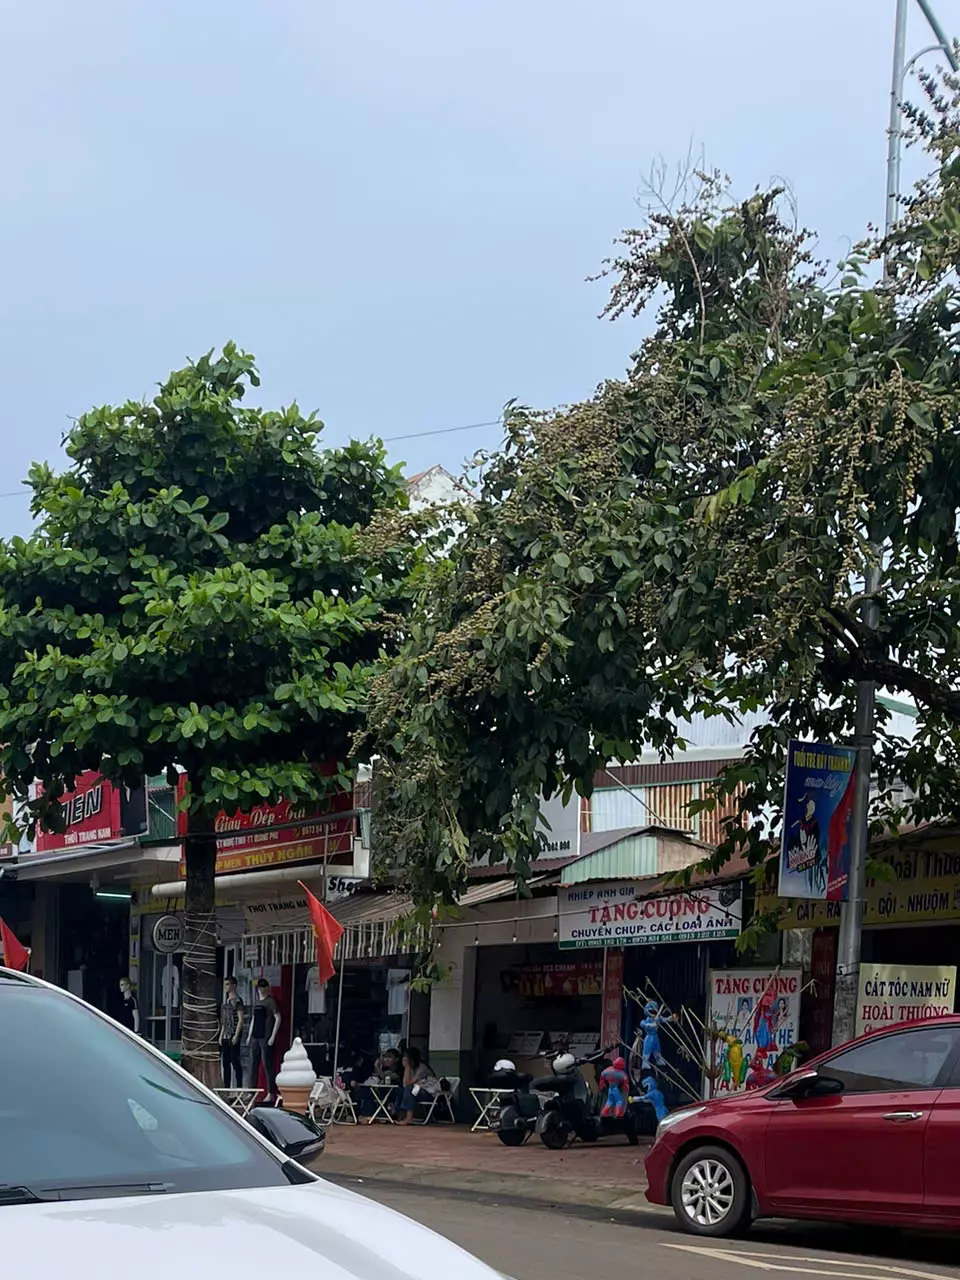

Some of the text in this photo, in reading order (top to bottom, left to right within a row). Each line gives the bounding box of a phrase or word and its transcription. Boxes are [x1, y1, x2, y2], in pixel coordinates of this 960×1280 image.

[619, 886, 635, 897] GIA
[589, 898, 638, 924] TĂNG
[158, 928, 180, 941] MEN
[571, 926, 612, 939] CHUYÊN
[716, 974, 749, 994] TĂNG
[865, 972, 951, 998] CẮT TÓC NAM NỮ
[862, 1001, 894, 1020] HOÀI
